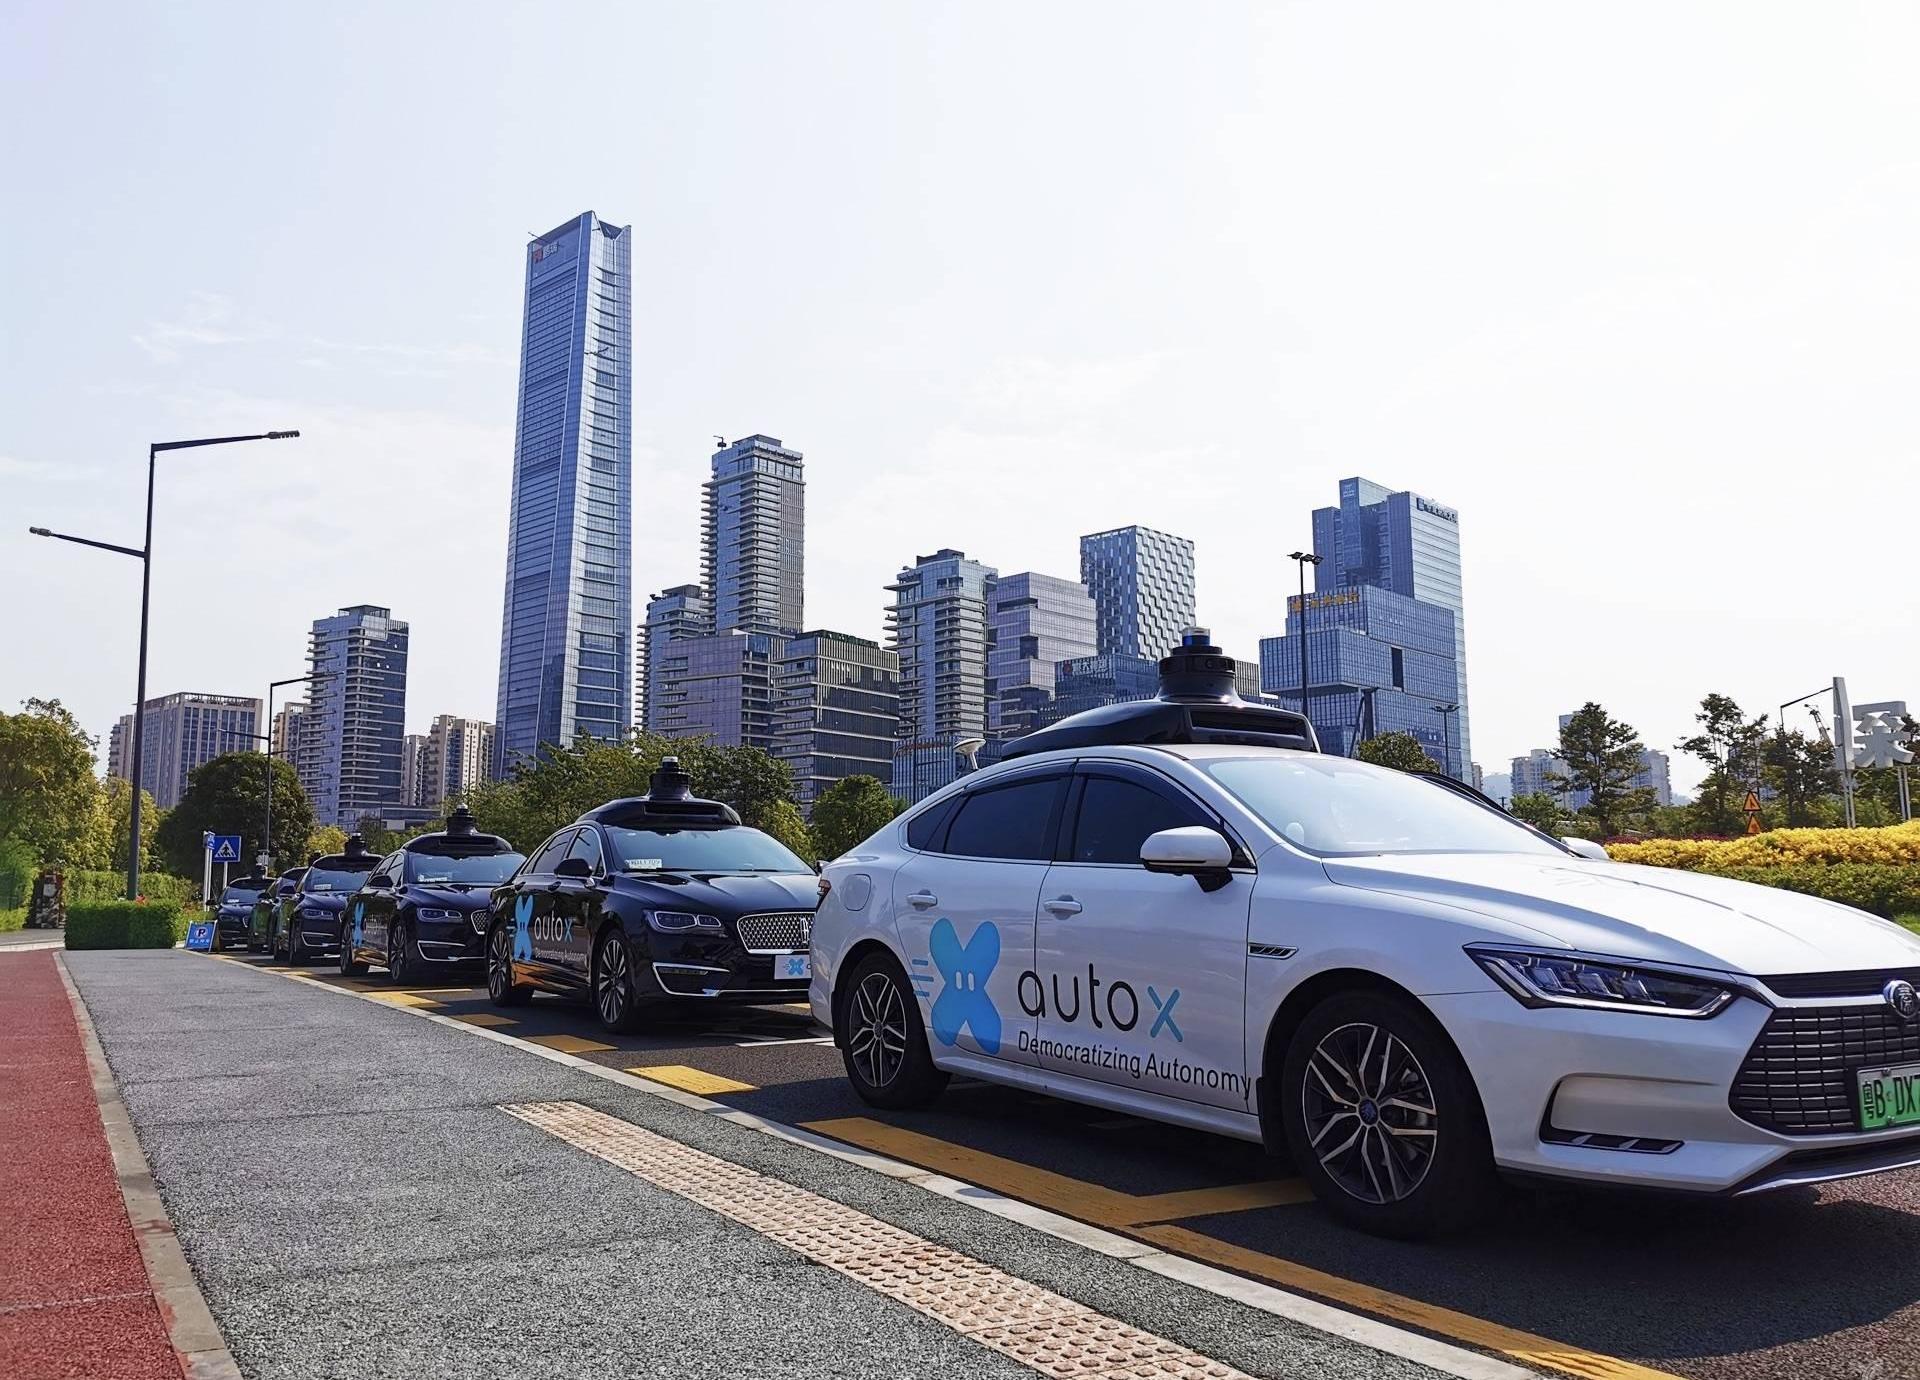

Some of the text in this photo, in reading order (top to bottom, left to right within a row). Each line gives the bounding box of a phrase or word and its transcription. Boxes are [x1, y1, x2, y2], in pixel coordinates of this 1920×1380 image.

[1017, 962, 1184, 1043] autox
[1018, 1030, 1252, 1101] Democratizing Autonomy
